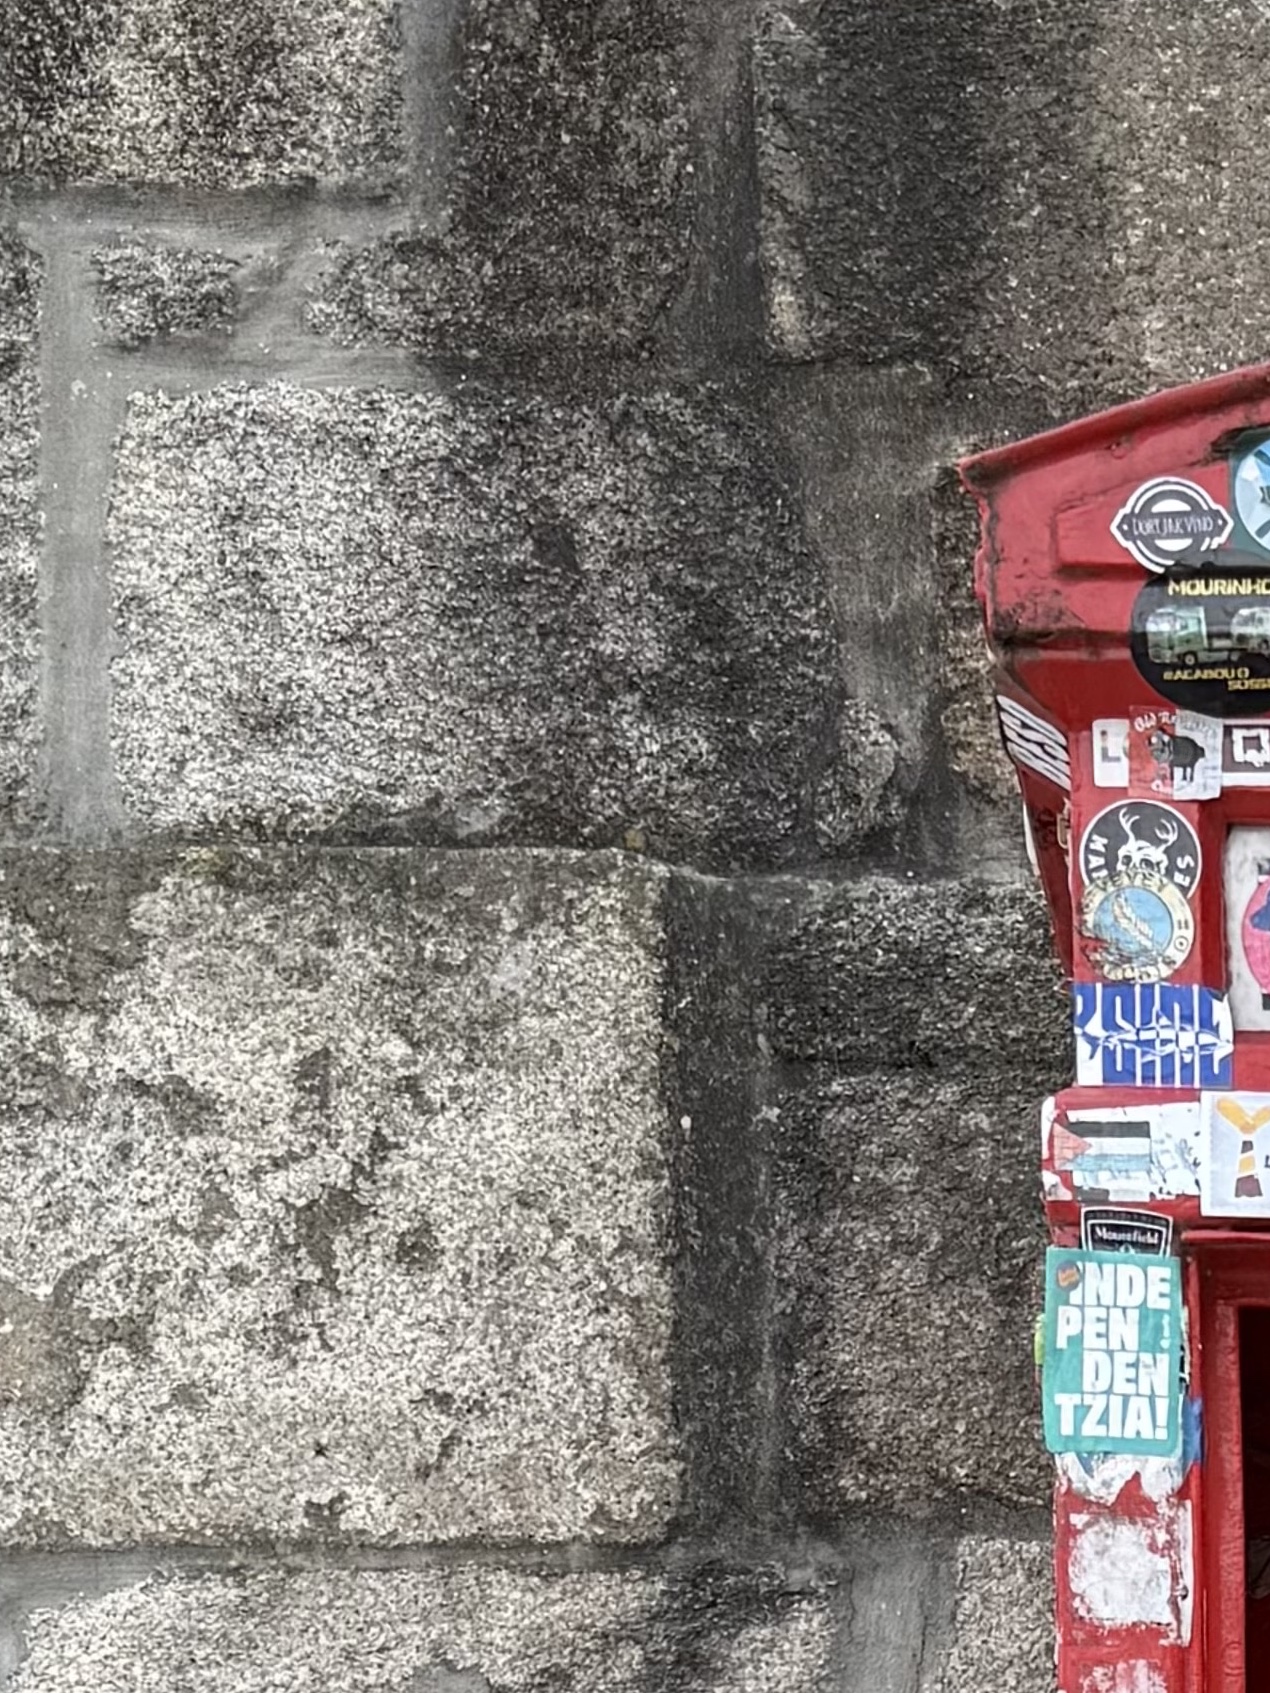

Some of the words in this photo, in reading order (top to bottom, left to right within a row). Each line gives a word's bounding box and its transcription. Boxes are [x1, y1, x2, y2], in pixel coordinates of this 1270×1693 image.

[1055, 1305, 1140, 1352] PEN
[1082, 1350, 1170, 1398] DEN
[1053, 1392, 1170, 1440] TZIA!
